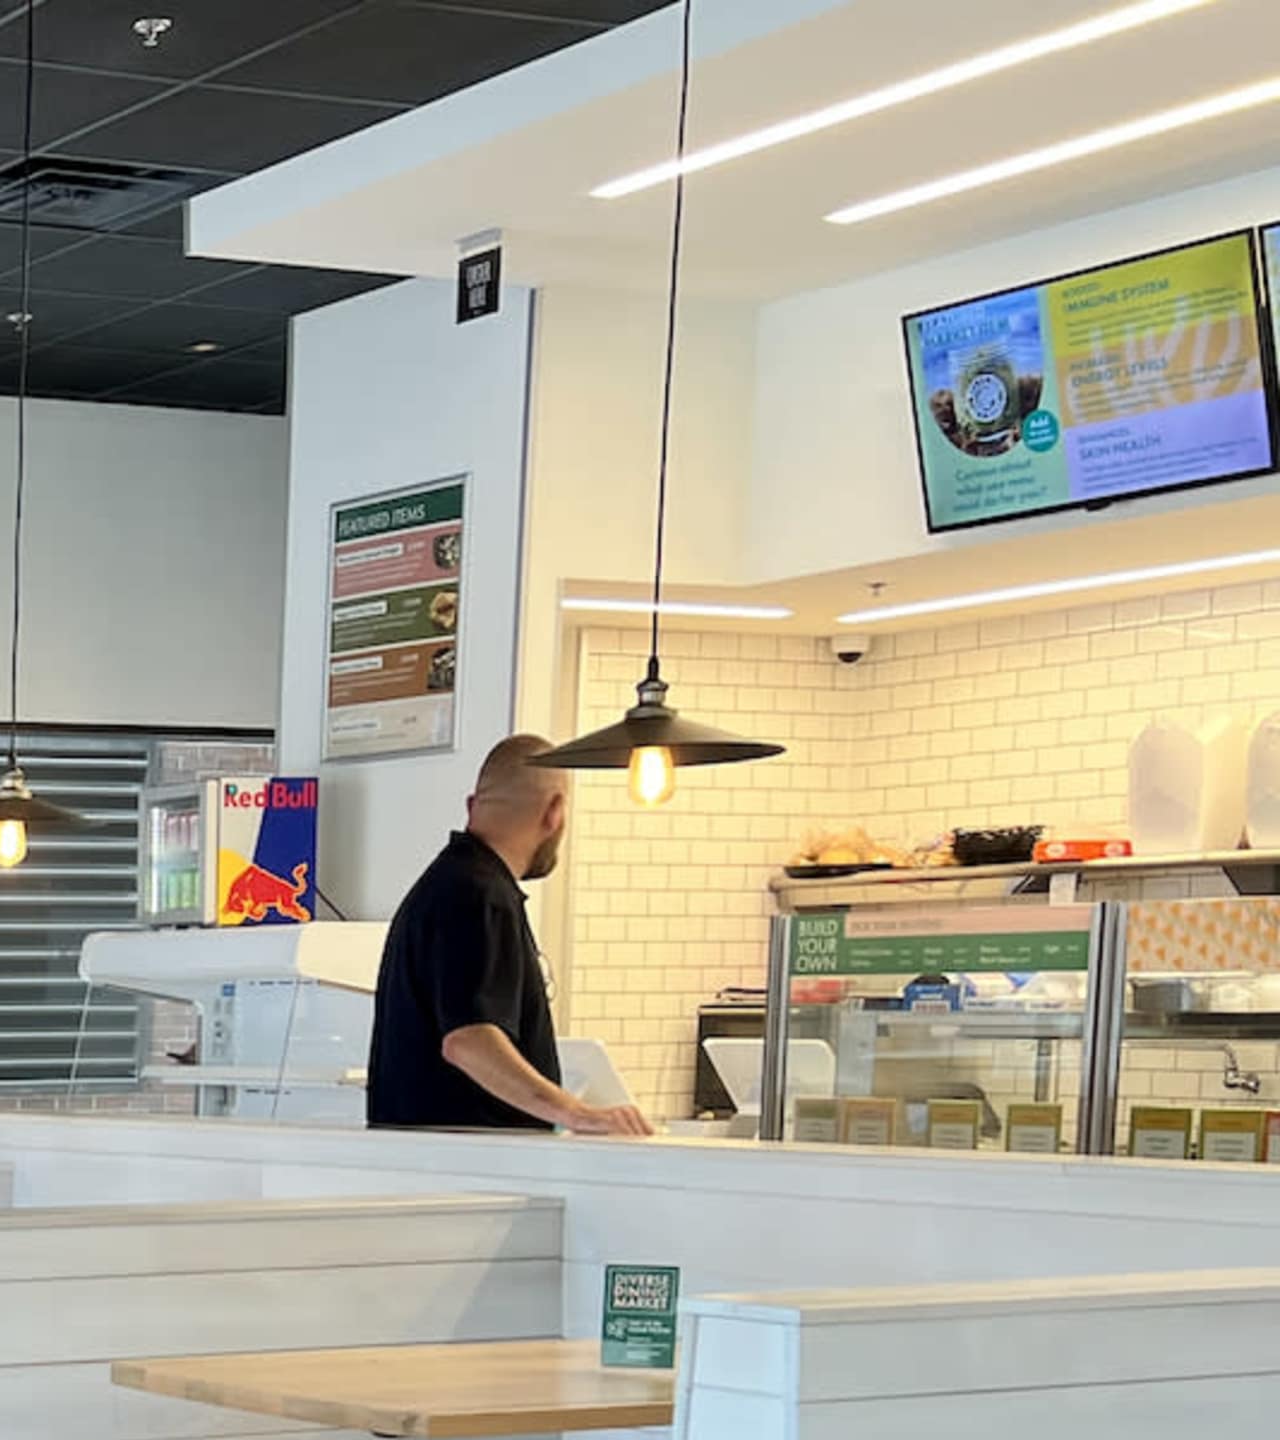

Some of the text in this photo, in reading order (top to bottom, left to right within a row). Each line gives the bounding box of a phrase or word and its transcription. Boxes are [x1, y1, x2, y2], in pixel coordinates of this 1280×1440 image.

[1122, 278, 1170, 301] SYSTEM
[1114, 433, 1162, 454] HEALTH
[338, 503, 426, 537] FEATURED ITEMS
[223, 781, 318, 808] Red Bull
[798, 919, 838, 937] BUILD
[798, 937, 838, 955] YOUR
[796, 955, 837, 973] OWN
[613, 1296, 667, 1311] MARKET
